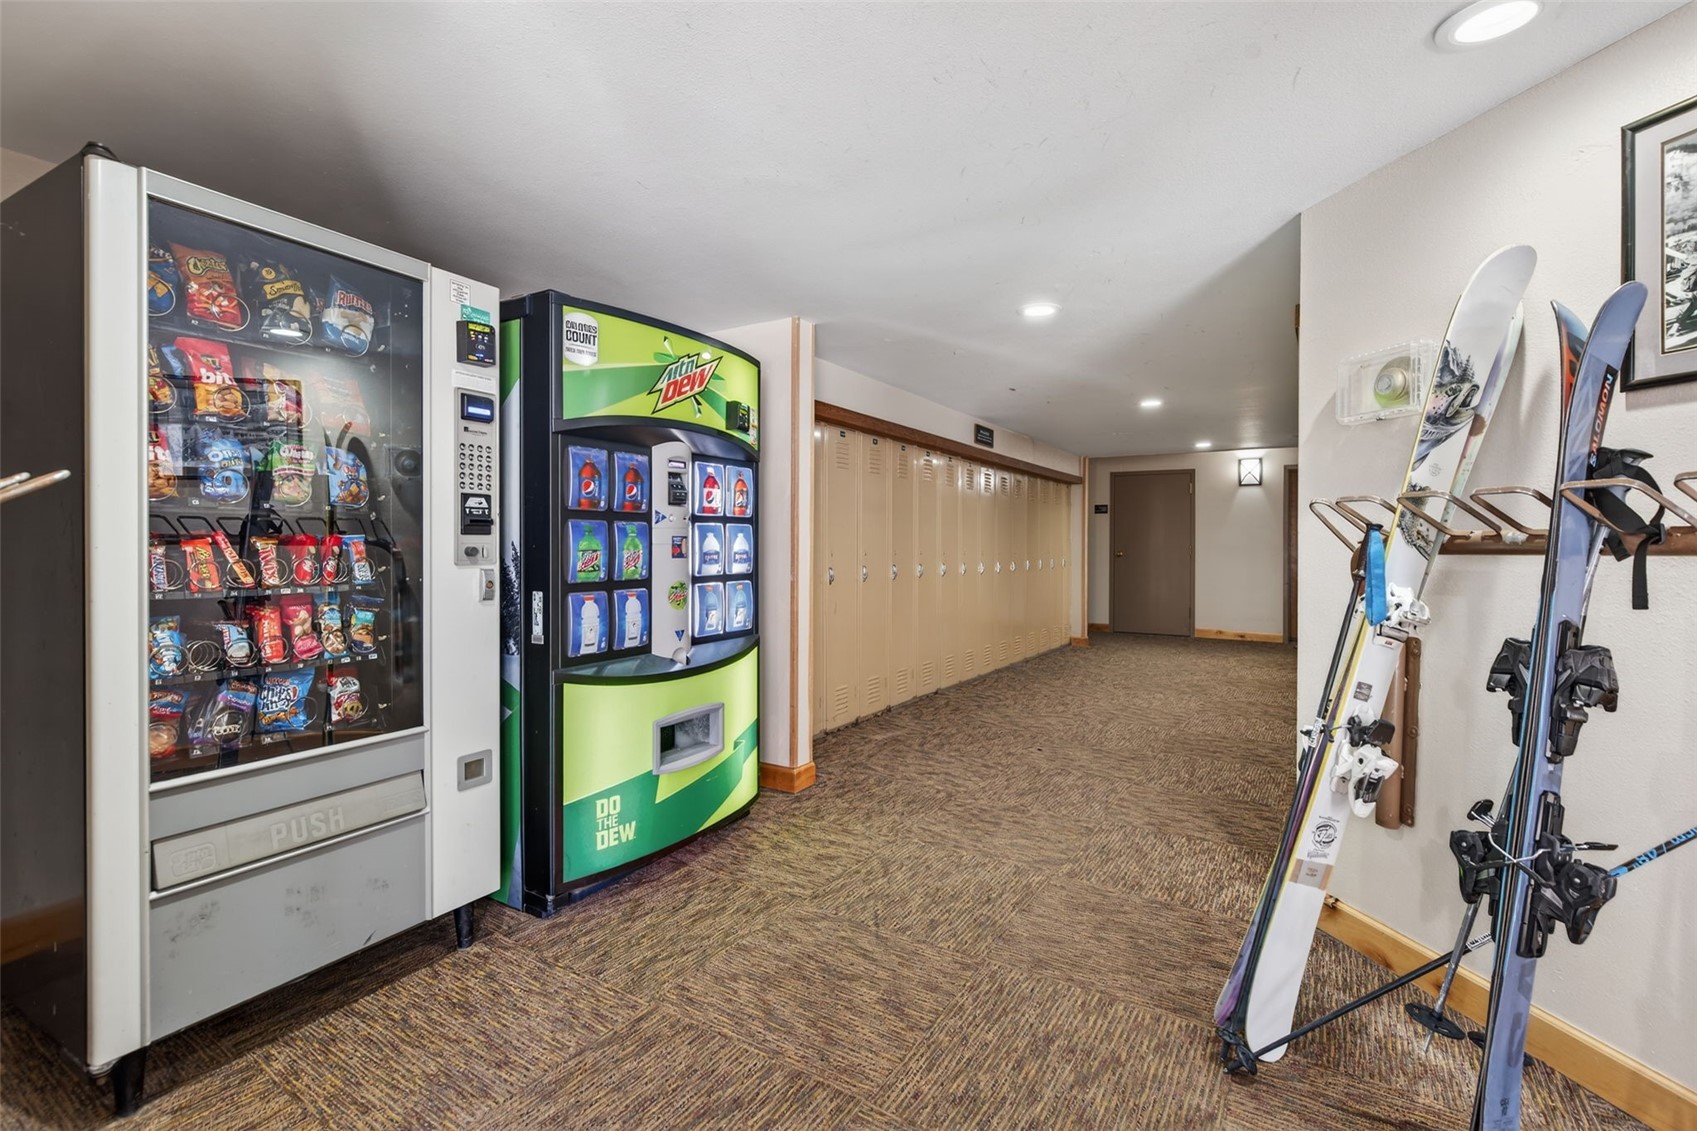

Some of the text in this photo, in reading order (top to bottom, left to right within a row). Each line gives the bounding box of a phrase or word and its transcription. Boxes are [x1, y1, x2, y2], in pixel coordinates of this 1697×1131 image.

[565, 330, 597, 346] COUNT
[1590, 373, 1614, 467] SALOMON
[595, 795, 621, 819] DO
[270, 806, 345, 849] PUSH
[596, 815, 619, 831] THE
